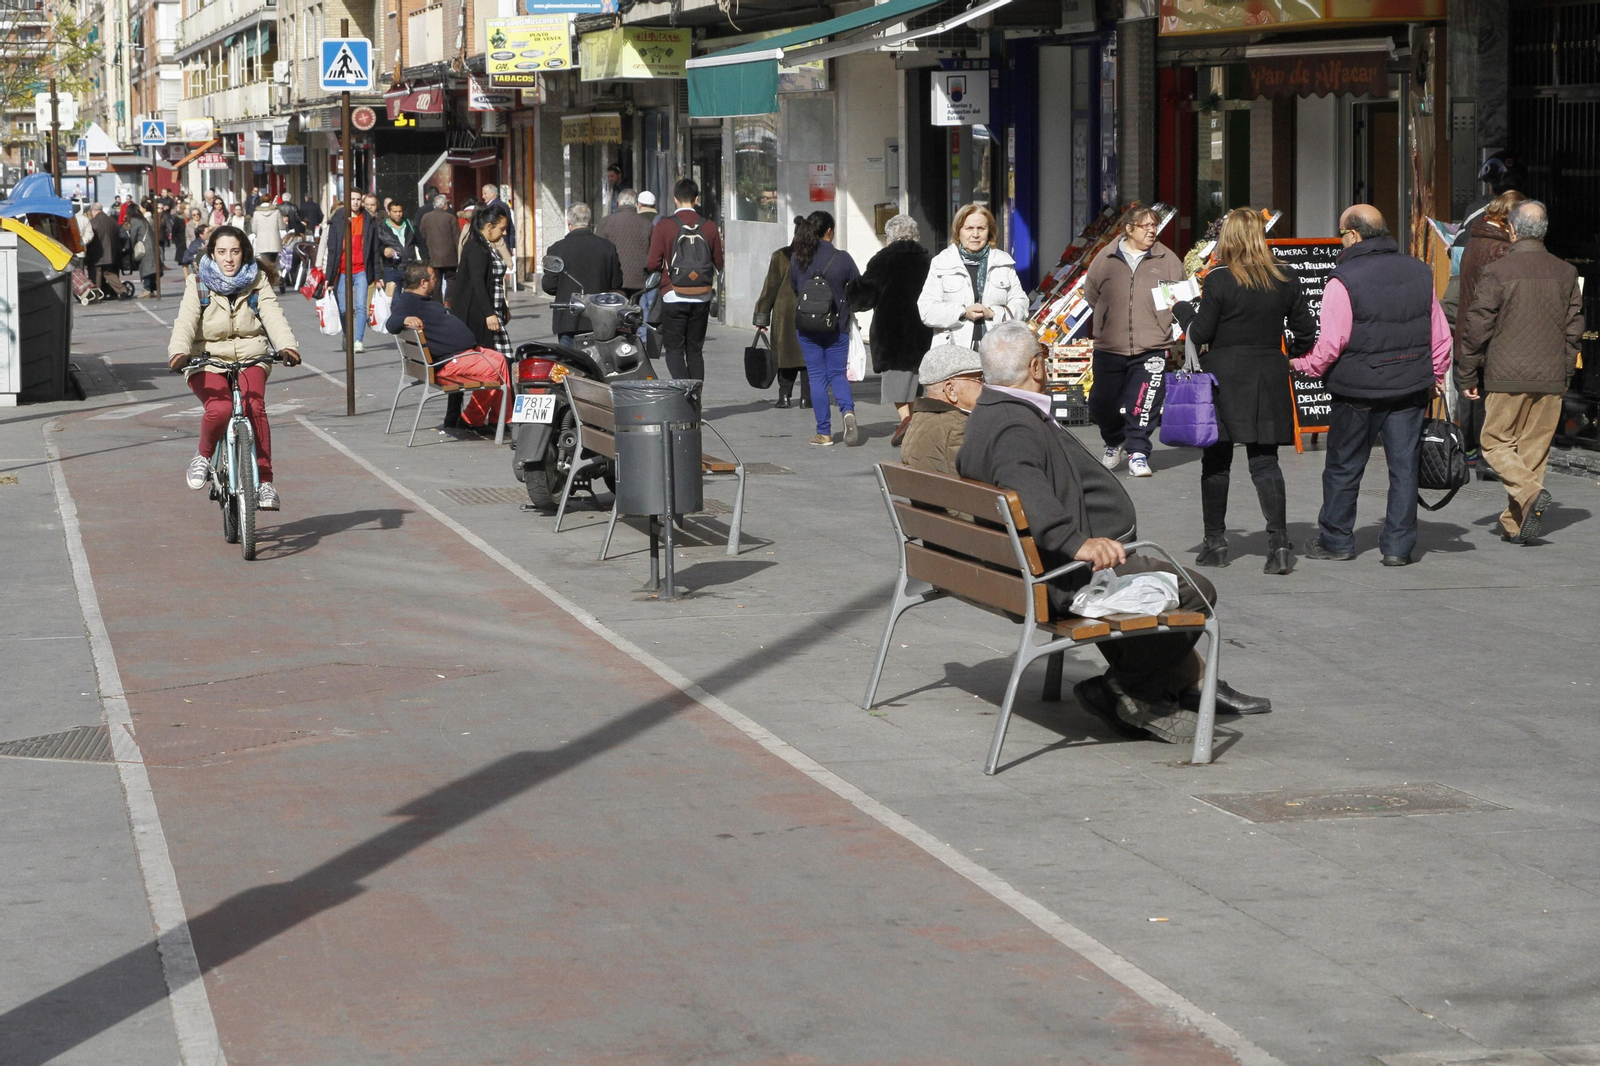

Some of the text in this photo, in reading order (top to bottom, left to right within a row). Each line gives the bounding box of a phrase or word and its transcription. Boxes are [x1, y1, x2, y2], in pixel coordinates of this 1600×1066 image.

[493, 74, 534, 83] TABACOS
[1251, 59, 1378, 90] Pan de Alfacar
[478, 96, 508, 104] UNISEX
[1272, 247, 1308, 257] PALMERAS
[1303, 261, 1337, 271] RELLENAS
[1300, 276, 1321, 284] DONUT
[1294, 380, 1325, 390] REGALE
[524, 396, 552, 409] 7812
[524, 408, 548, 420] FNW
